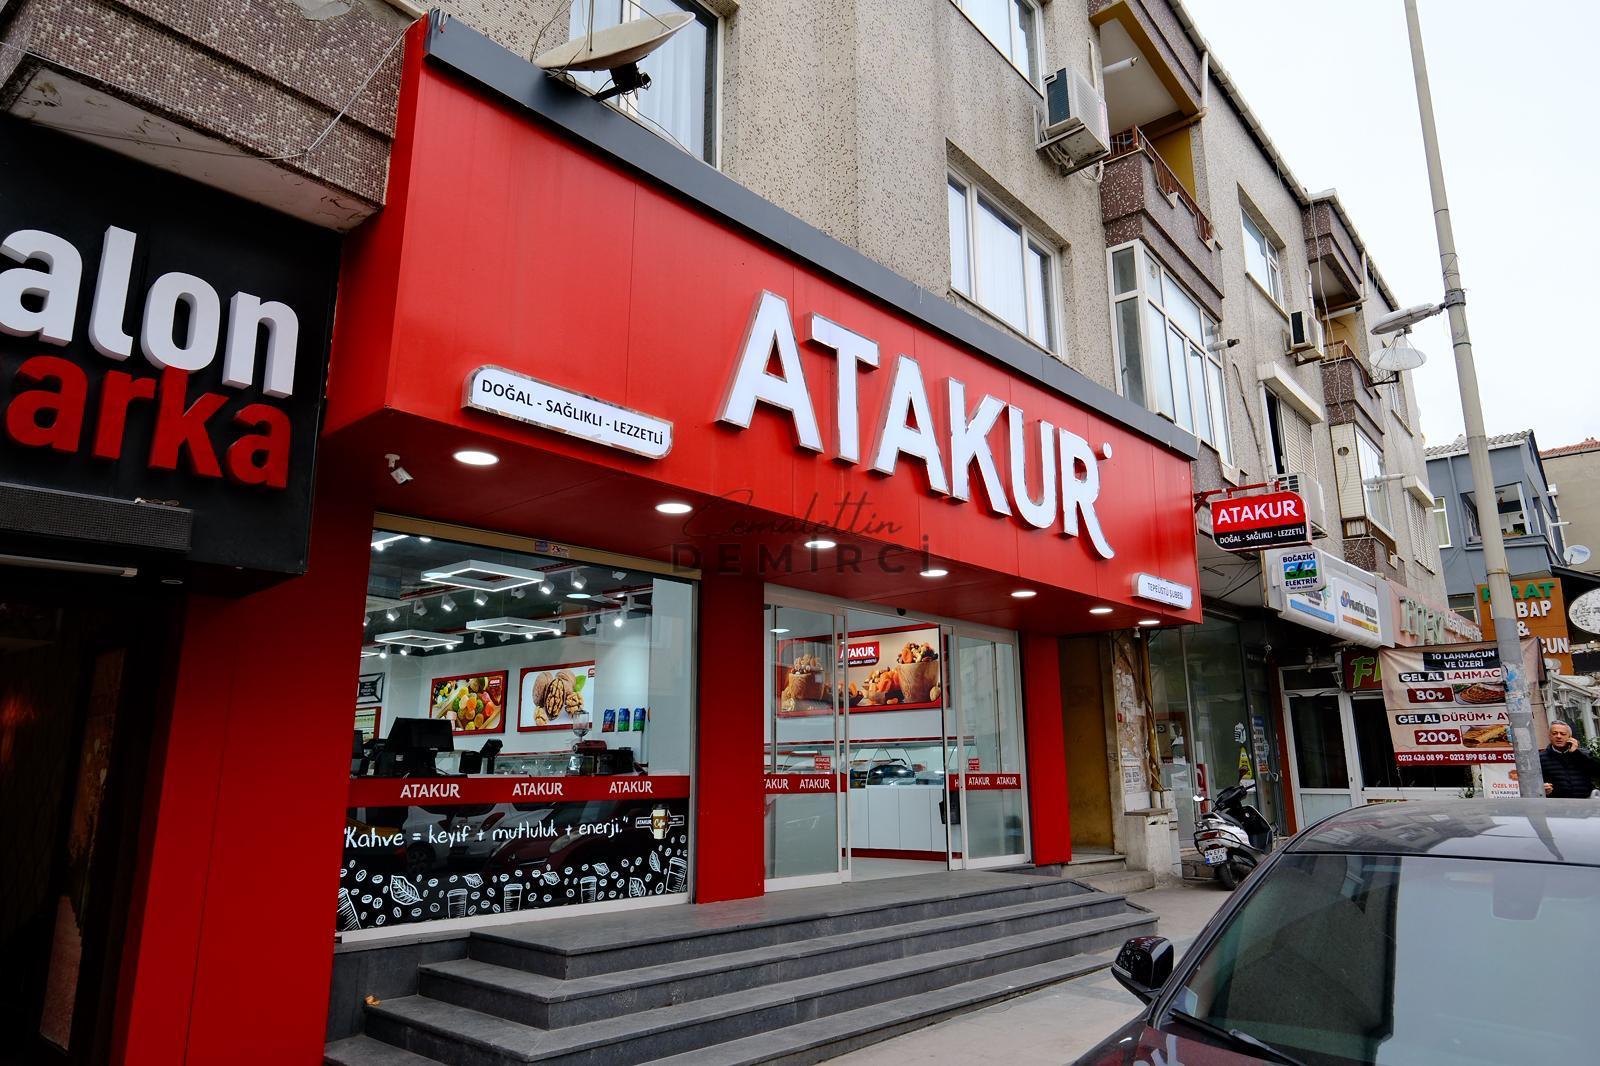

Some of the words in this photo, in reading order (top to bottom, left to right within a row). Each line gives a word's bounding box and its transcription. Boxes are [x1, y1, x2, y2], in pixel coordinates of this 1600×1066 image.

[481, 378, 534, 407] DOĞAL
[545, 399, 603, 427] SAĞLIKLI
[613, 419, 664, 446] LEZZETLİ
[6, 355, 291, 489] arka
[713, 288, 1115, 560] ATAKUR
[1217, 499, 1300, 525] ATAKUR
[1219, 534, 1242, 544] DOĞAL
[1246, 530, 1273, 542] SAĞLIKLI
[1277, 525, 1305, 538] LEZZETLİ
[1282, 551, 1316, 563] BOĞAZİÇİ
[1285, 577, 1318, 587] ELEKTRİK
[1443, 650, 1495, 660] LAHMACUN
[1444, 661, 1457, 669] VE
[1458, 659, 1484, 668] ÜZERİ
[1401, 672, 1425, 682] GEL
[1427, 671, 1443, 681] AL
[1398, 715, 1421, 724] GEL
[1423, 713, 1439, 723] AL
[1397, 754, 1413, 762] 0212
[1449, 753, 1465, 761] 0212
[799, 778, 831, 790] ATAKUR
[968, 776, 990, 786] ATAKUR
[996, 776, 1018, 786] ATAKUR
[400, 783, 461, 799] ATAKUR
[512, 782, 564, 797] ATAKUR
[609, 781, 653, 794] ATAKUR
[428, 824, 471, 848] keyif
[492, 819, 558, 840] mutluluk
